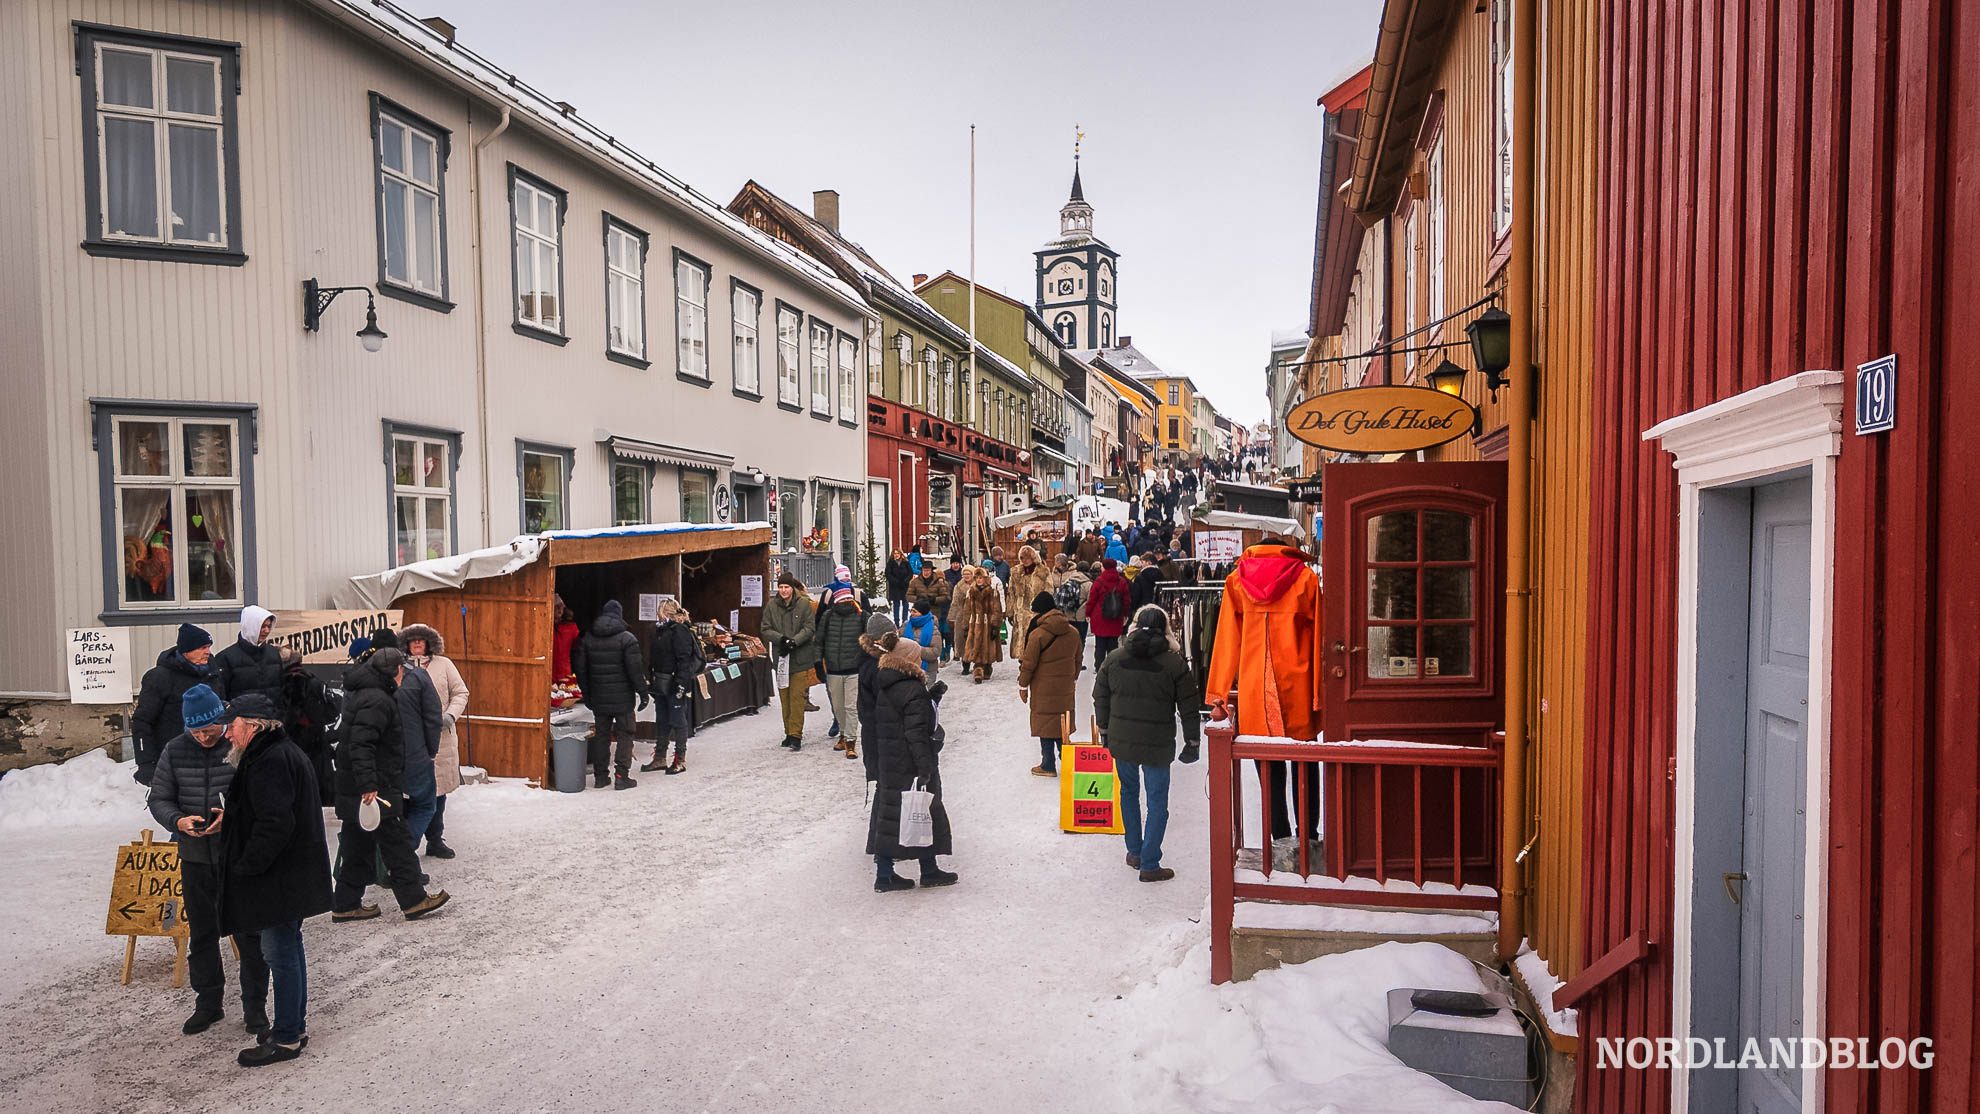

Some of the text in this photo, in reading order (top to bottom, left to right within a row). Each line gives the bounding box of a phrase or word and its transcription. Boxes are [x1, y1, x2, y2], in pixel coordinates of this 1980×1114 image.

[1865, 369, 1886, 424] 19
[1297, 406, 1464, 435] Det Gule Huset
[902, 412, 957, 446] LARS
[82, 643, 114, 652] PERSA
[75, 654, 111, 665] GÅRDEN
[1080, 751, 1107, 760] Siste
[1087, 781, 1099, 797] 4
